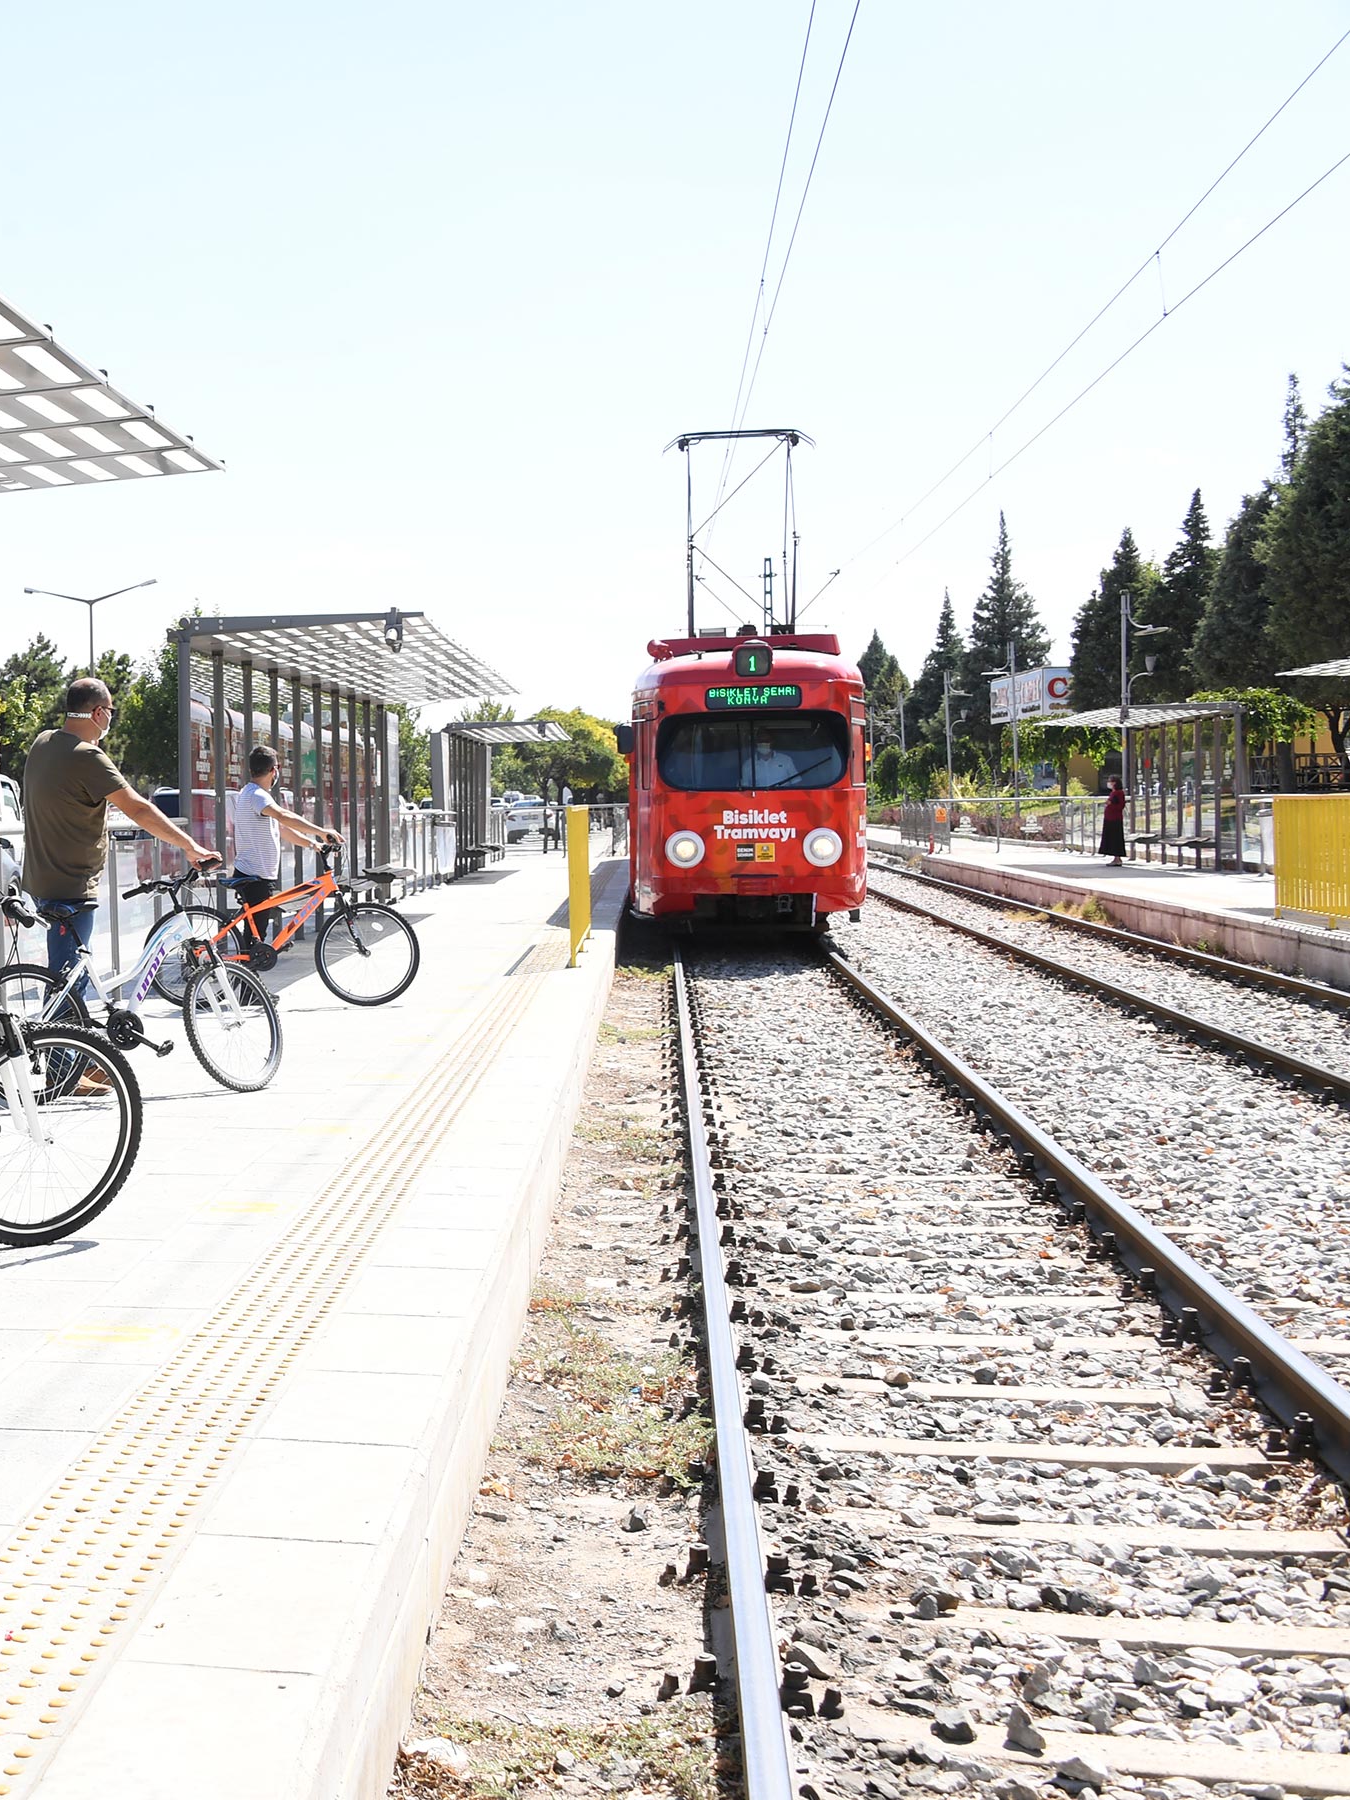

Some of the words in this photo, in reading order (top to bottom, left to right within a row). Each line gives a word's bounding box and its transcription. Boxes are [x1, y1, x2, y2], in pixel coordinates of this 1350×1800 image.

[749, 656, 756, 671] 1
[727, 695, 768, 705] KONYA
[723, 809, 787, 824] Bisiklet
[714, 825, 796, 842] Tramvayı
